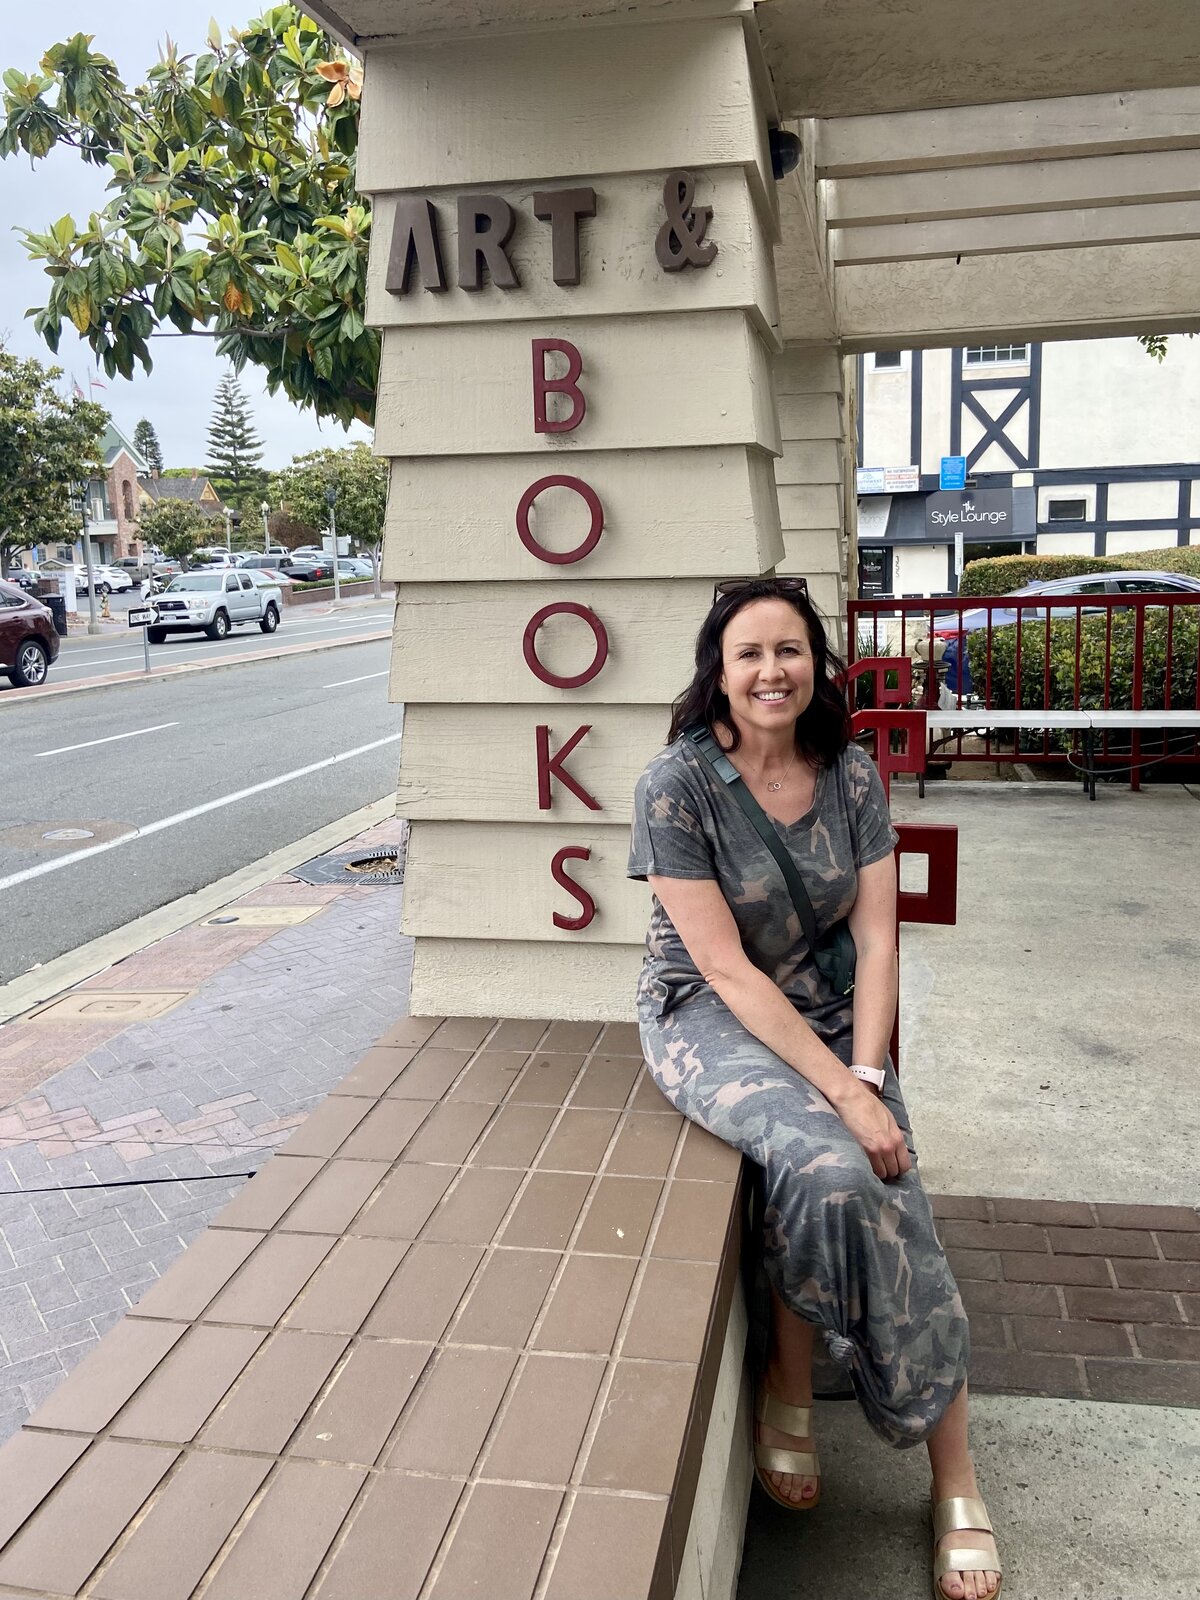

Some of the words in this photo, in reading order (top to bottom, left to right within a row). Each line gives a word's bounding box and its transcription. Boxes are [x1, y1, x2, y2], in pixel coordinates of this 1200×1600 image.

[385, 187, 597, 295] ART
[655, 170, 718, 273] &
[931, 510, 959, 527] Style
[961, 510, 1007, 525] Lounge
[131, 614, 141, 622] ONE
[142, 612, 151, 620] WAY
[516, 338, 609, 931] BOOKS
